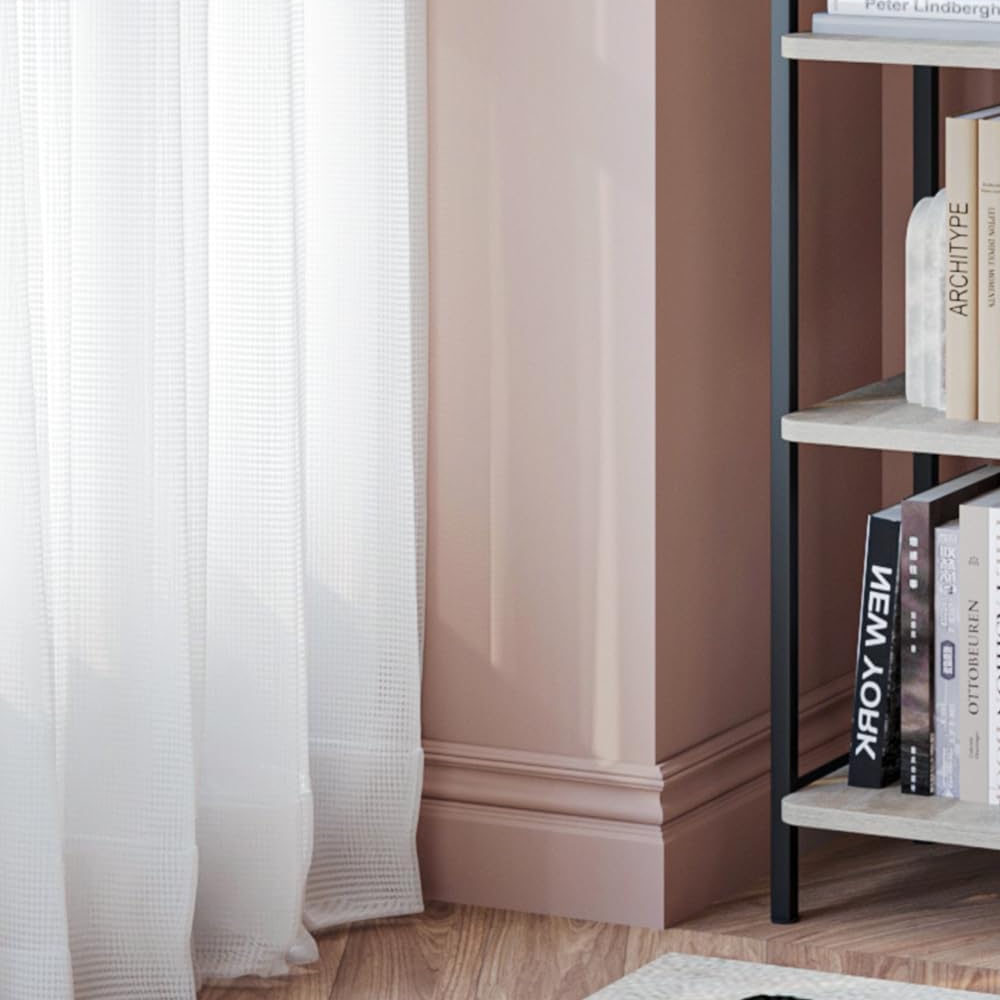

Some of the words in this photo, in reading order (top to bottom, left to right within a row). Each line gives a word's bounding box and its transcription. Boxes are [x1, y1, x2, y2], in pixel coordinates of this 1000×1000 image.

[914, 0, 1000, 19] Lindbergh
[948, 202, 969, 317] ARCHITYPE
[968, 599, 980, 716] OTTOBEUREN
